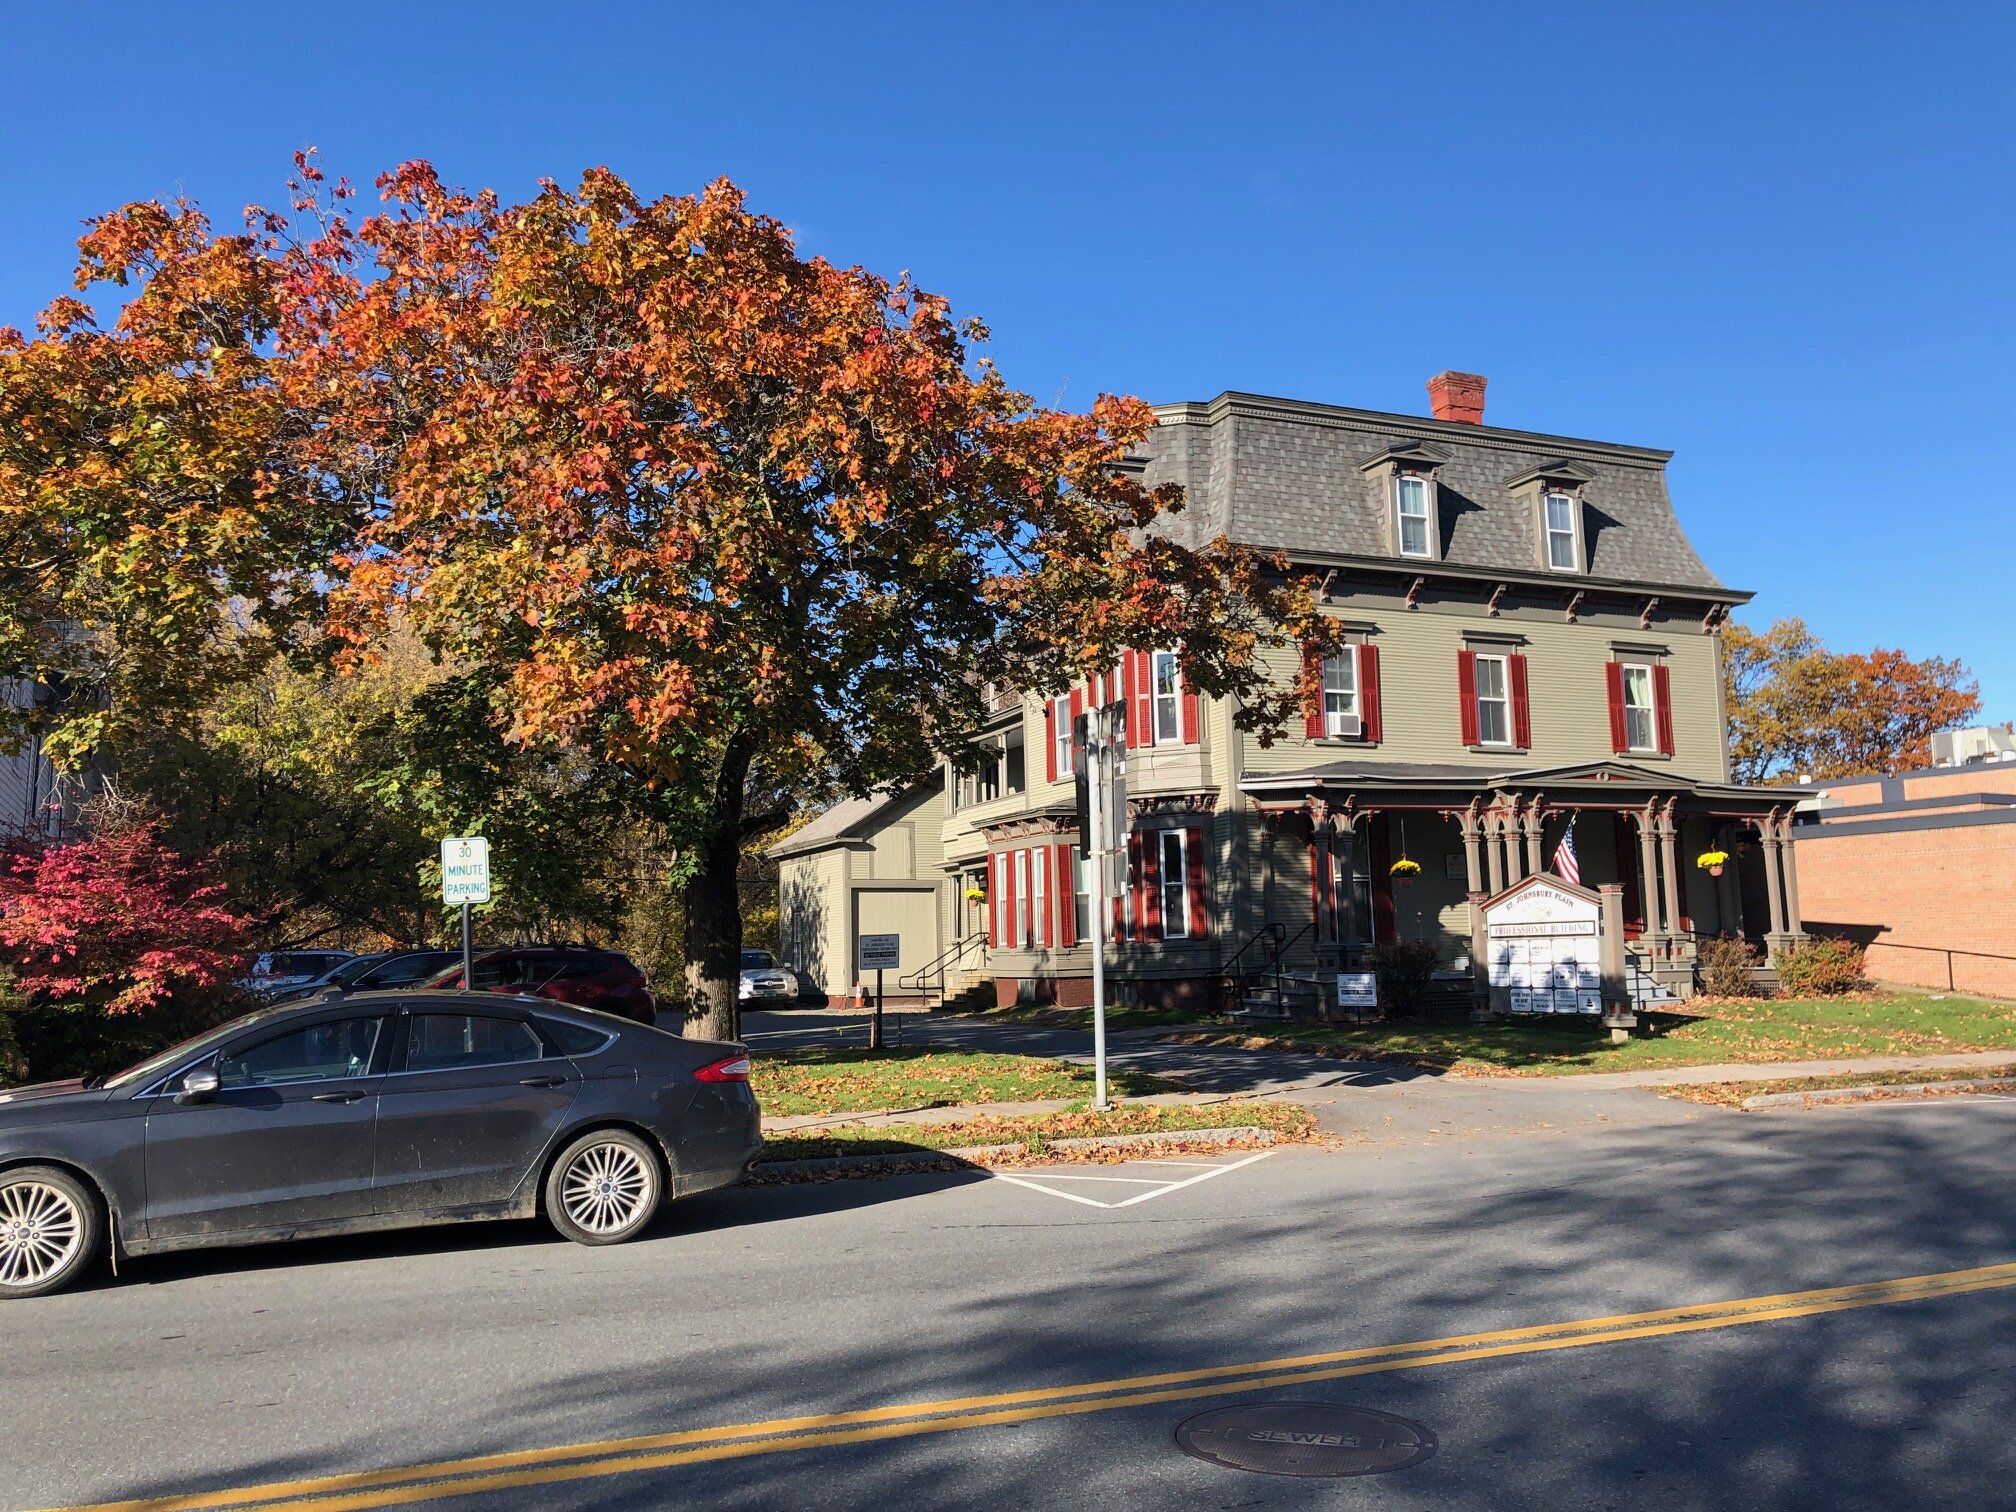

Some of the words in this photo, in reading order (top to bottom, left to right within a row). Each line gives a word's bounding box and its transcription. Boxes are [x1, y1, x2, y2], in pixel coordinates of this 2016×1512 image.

[458, 847, 472, 858] 30
[448, 864, 483, 877] MINUTE
[447, 882, 486, 895] PARKING
[1516, 890, 1552, 904] JOHNSBURY
[1554, 891, 1574, 907] PLAIN
[1494, 925, 1547, 935] PROFESSIONAL
[1550, 924, 1588, 934] BUILDING
[1247, 1430, 1361, 1447] SEWER
